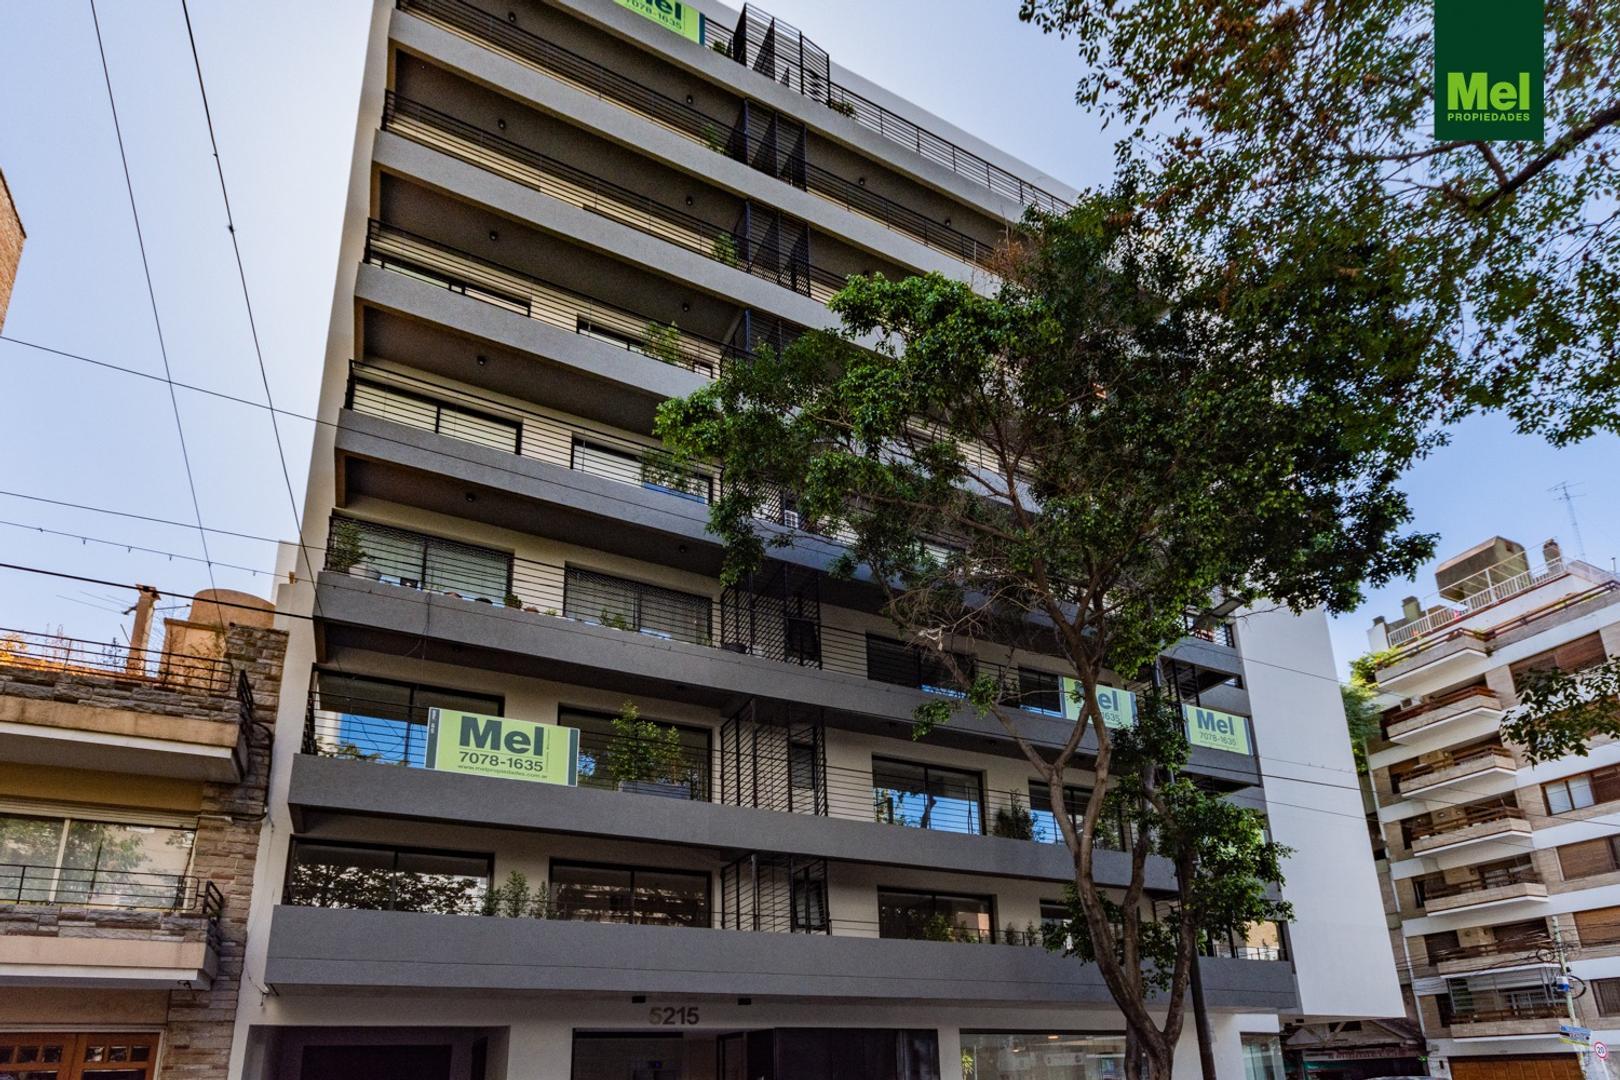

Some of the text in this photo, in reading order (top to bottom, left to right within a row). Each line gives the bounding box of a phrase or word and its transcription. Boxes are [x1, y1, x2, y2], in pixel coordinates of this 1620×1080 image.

[1196, 709, 1234, 736] Mel
[459, 715, 544, 756] Mel
[1200, 732, 1236, 746] 7078-1635
[459, 751, 543, 772] 7078-1635
[650, 1007, 699, 1025] 5215
